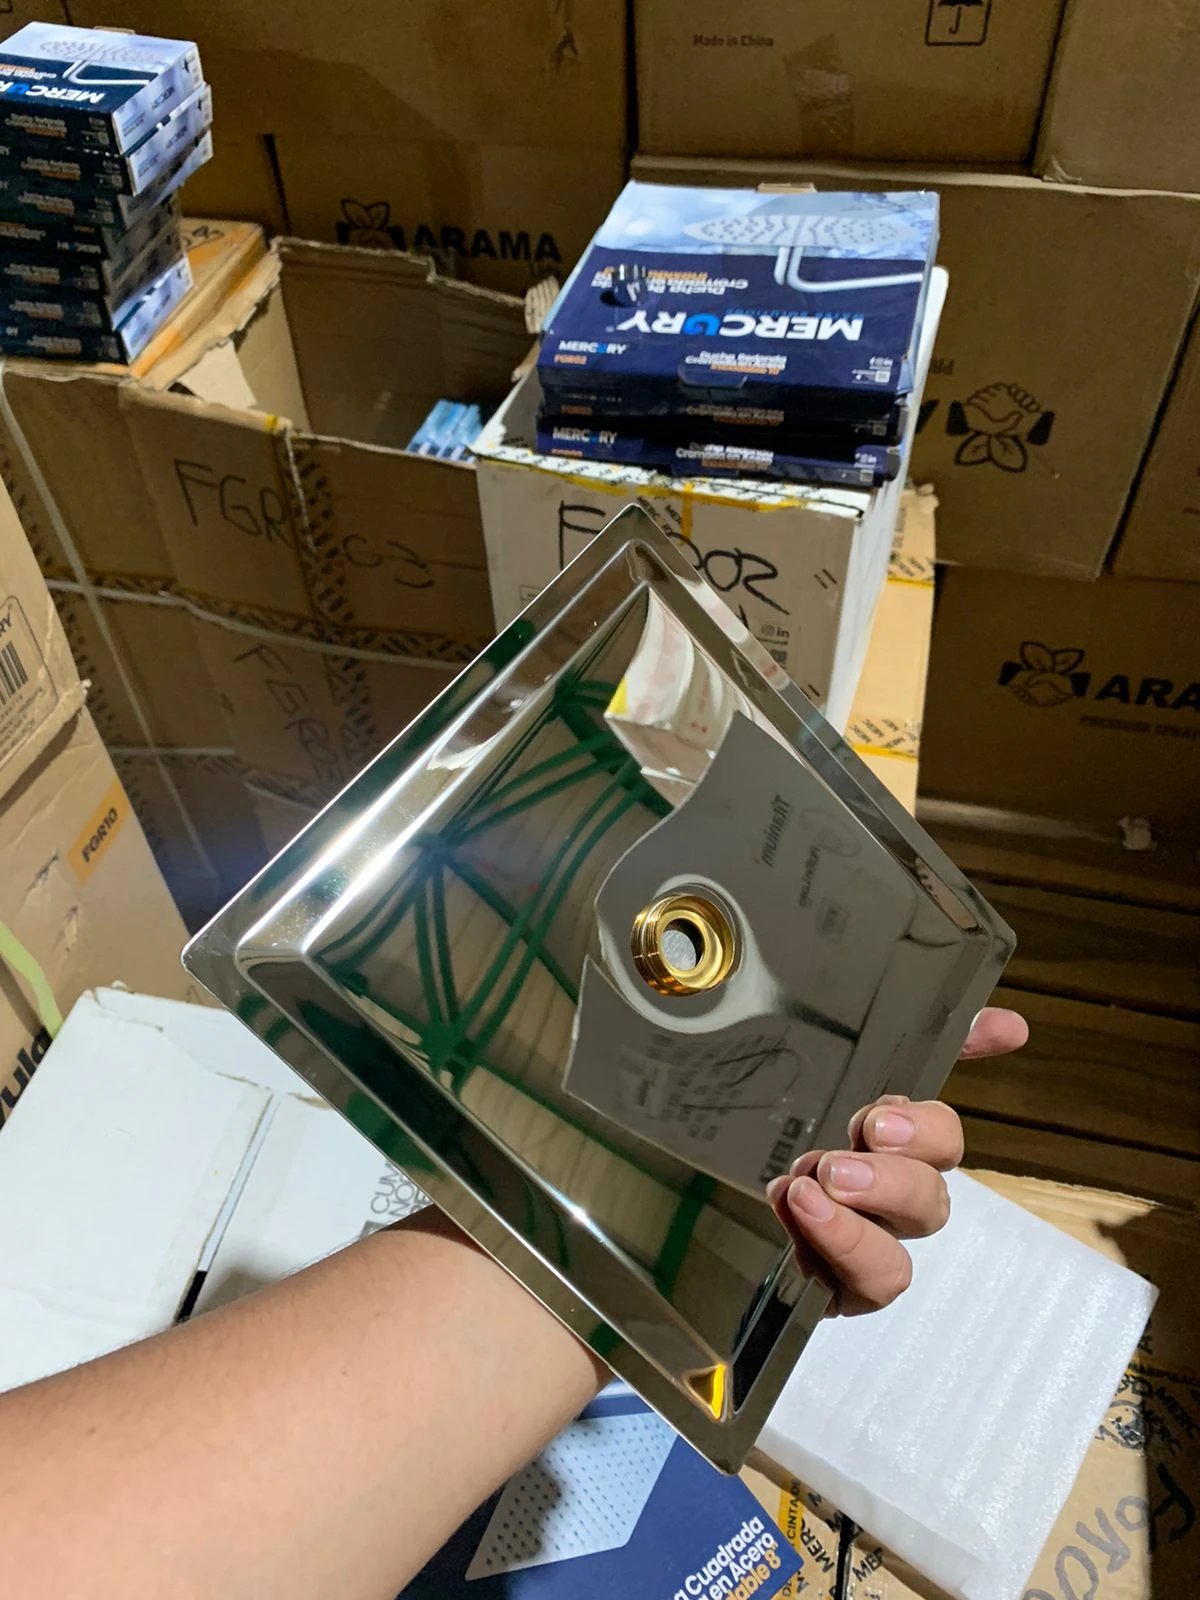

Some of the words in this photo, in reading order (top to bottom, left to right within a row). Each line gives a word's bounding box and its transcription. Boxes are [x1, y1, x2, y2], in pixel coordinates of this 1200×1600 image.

[692, 34, 724, 47] Made
[726, 34, 738, 46] in
[741, 34, 774, 47] China
[413, 224, 562, 262] ARAMA
[616, 310, 865, 341] MERCURY
[558, 340, 627, 355] MERCURY
[552, 426, 618, 444] MERCURY
[786, 1498, 801, 1540] CINTA
[685, 1516, 765, 1596] Cuadrada
[709, 1574, 734, 1600] en
[730, 1532, 775, 1583] Acero
